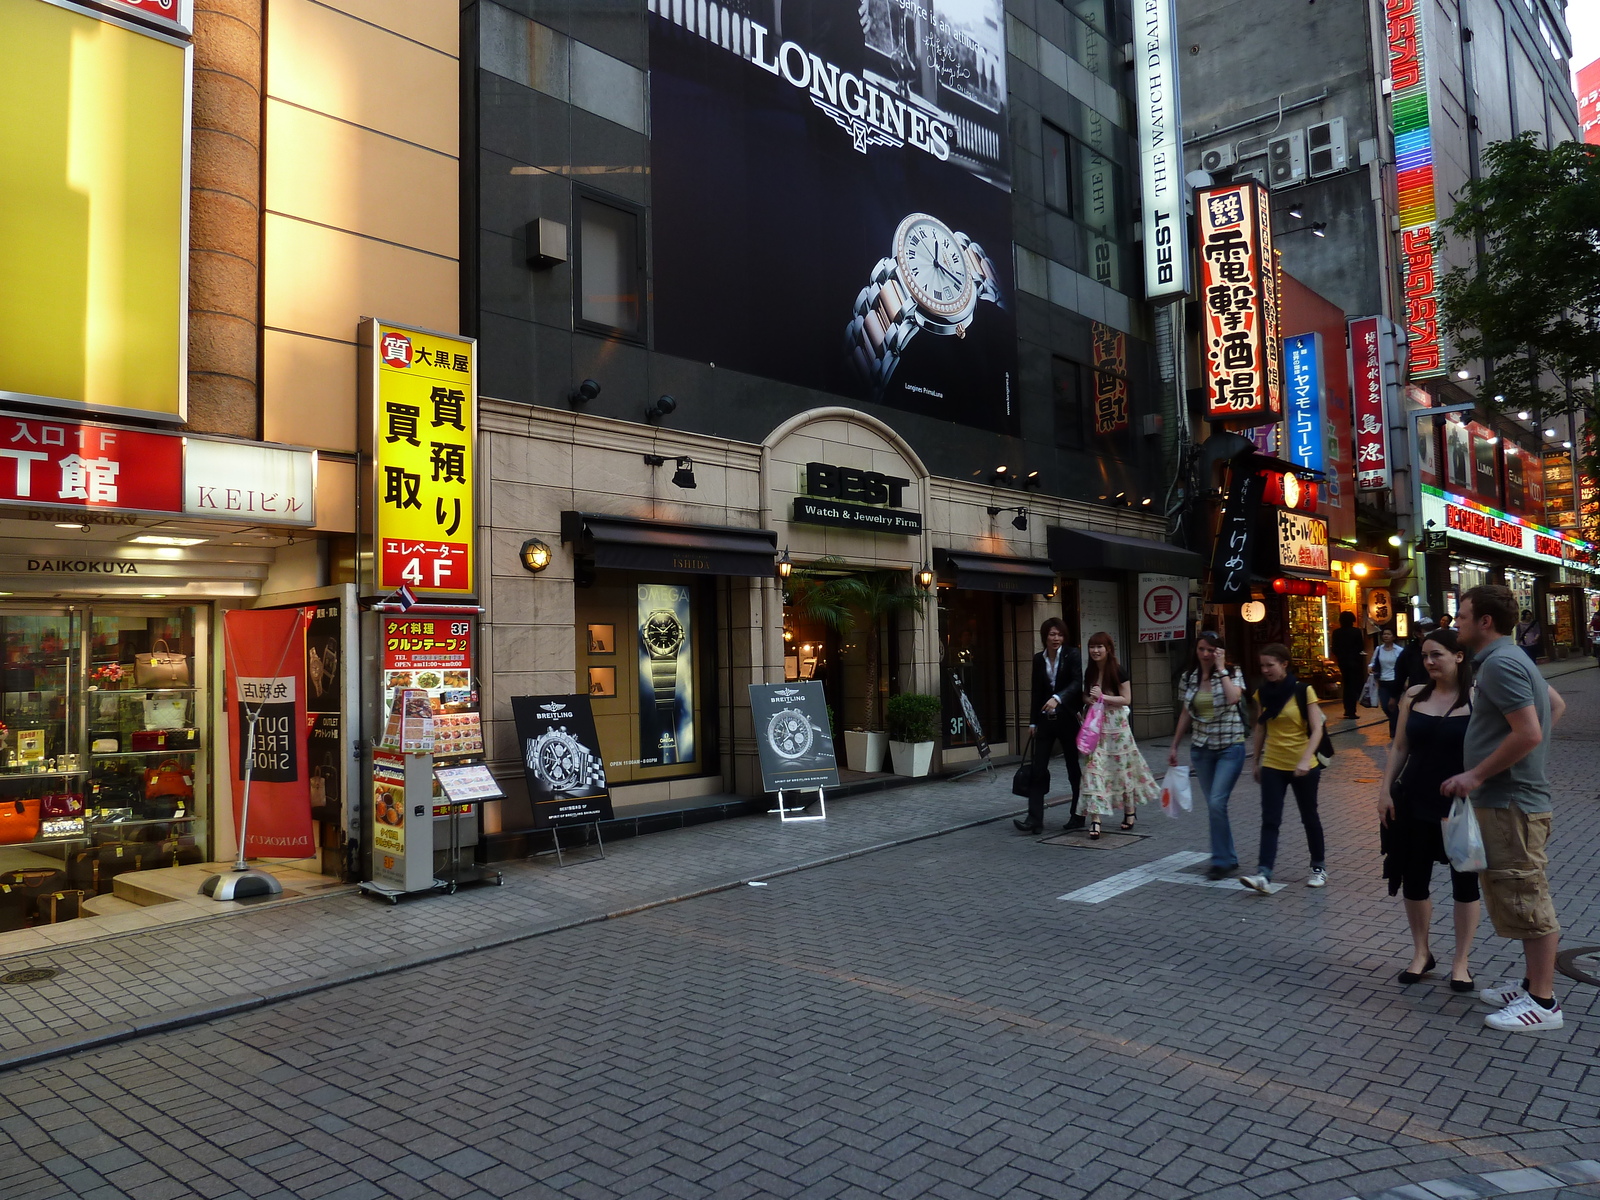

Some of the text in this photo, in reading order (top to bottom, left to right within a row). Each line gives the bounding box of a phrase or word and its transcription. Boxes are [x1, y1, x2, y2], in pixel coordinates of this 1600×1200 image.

[896, 0, 928, 21] gance
[930, 10, 937, 26] is
[940, 20, 951, 36] an
[953, 29, 986, 57] attitude
[750, 21, 949, 161] LONGINES
[1580, 88, 1600, 108] カラ
[1149, 73, 1163, 148] WATCH
[1153, 152, 1167, 198] THE
[1154, 209, 1173, 285] BEST
[1403, 226, 1440, 372] ビックカメラ
[1205, 230, 1256, 410] 電撃酒場
[384, 337, 470, 373] 質 大黒屋
[904, 382, 922, 393] Longines
[385, 402, 422, 510] 買取
[430, 386, 466, 536] 質預り
[1476, 459, 1494, 478] LUMIX
[806, 462, 910, 508] BEST
[197, 485, 304, 514] KEIビル
[805, 505, 920, 528] Watch & Jewelry Firm.
[387, 543, 464, 558] エレベーター
[27, 559, 138, 574] DAIKOKUYA
[402, 558, 453, 586] 4F
[638, 587, 690, 602] OMEGA
[1153, 594, 1174, 616] 買
[388, 622, 468, 635] タイ料理 3F
[322, 718, 338, 726] OUTLET
[536, 712, 574, 720] BREITLING
[950, 717, 964, 735] 3F
